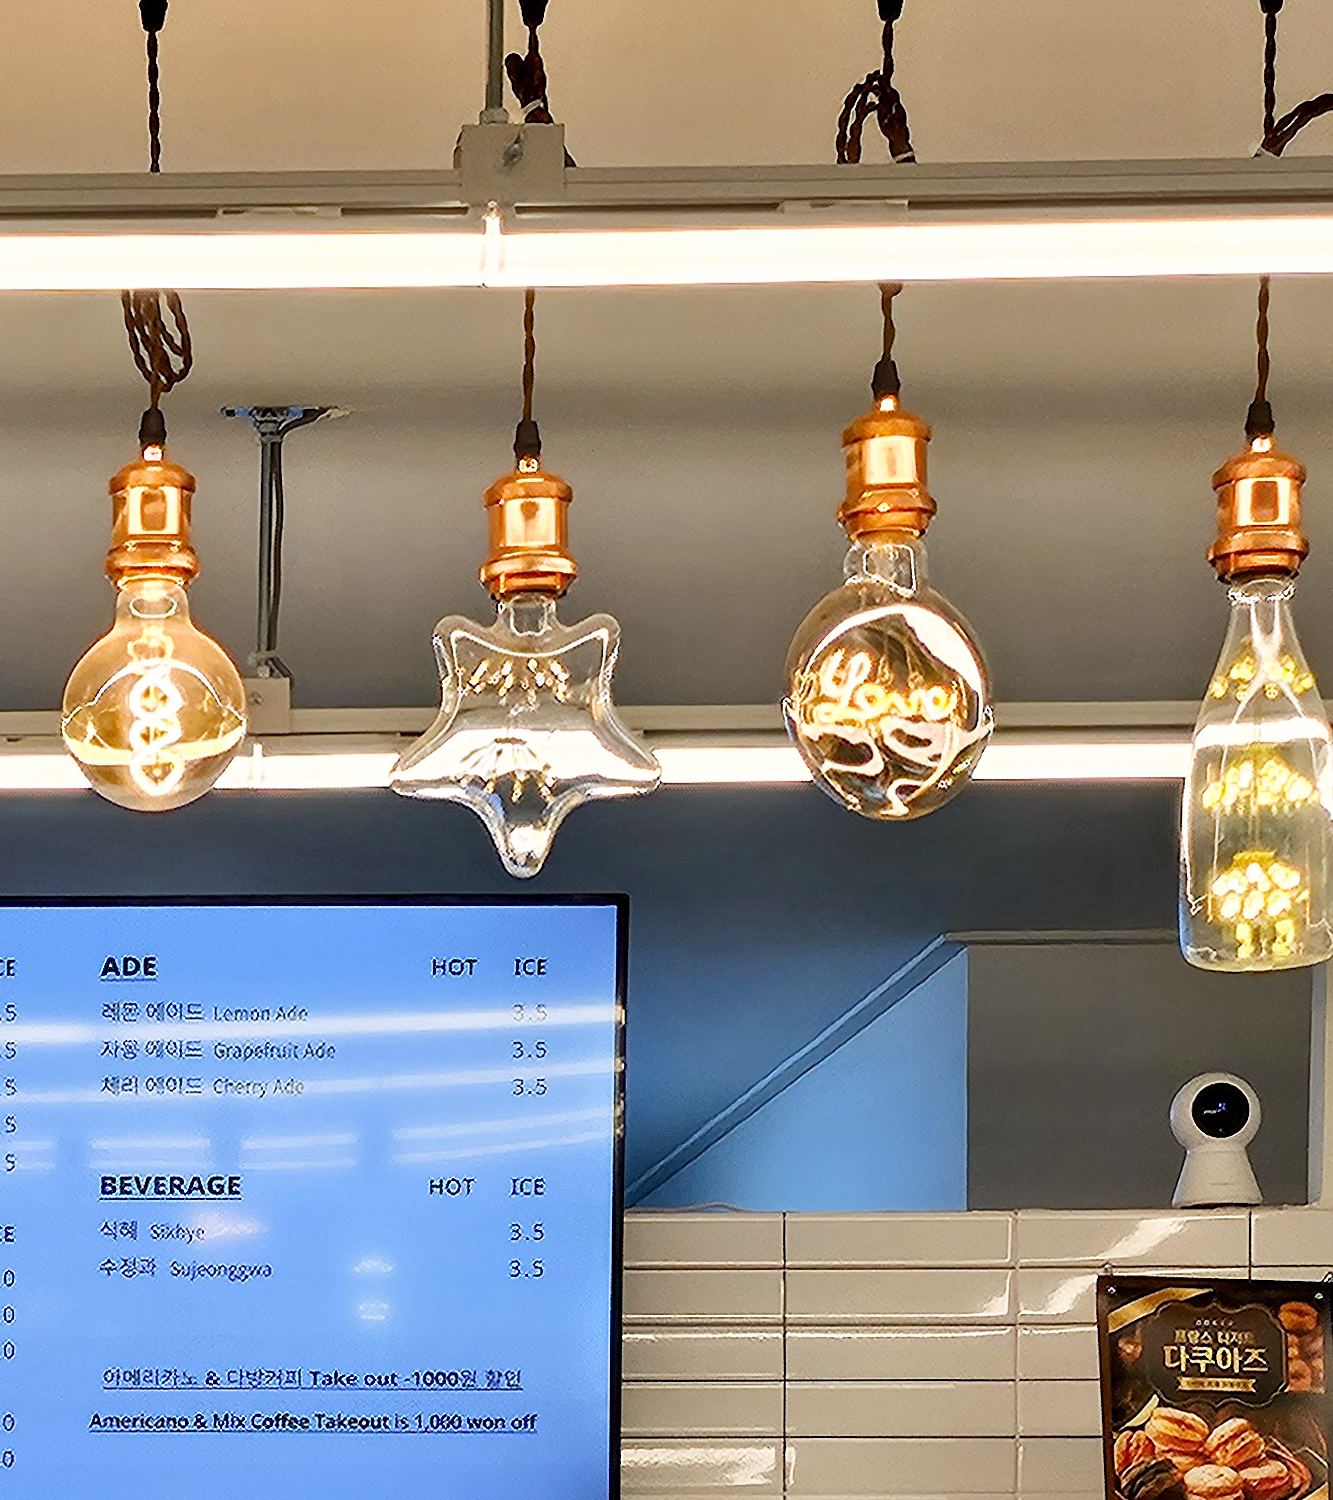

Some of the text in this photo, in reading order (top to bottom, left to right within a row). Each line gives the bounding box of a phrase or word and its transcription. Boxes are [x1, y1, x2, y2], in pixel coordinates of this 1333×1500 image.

[99, 957, 547, 977] ADE HOT ICE
[146, 1002, 203, 1022] 에이드
[213, 1005, 269, 1021] Lemon
[275, 1005, 308, 1021] Ade
[146, 1041, 203, 1060] 에이드
[213, 1043, 298, 1062] Grapefruit
[303, 1043, 335, 1059] Ade
[512, 1041, 547, 1059] 3.5
[146, 1077, 203, 1096] 에이드
[213, 1078, 267, 1097] Cherry
[273, 1078, 304, 1095] Ade
[512, 1078, 547, 1096] 3.5
[99, 1176, 546, 1196] BEVERAGE HOT ICE
[510, 1223, 545, 1241] 3.5
[100, 1258, 157, 1278] 수정과
[510, 1260, 545, 1278] 3.5
[1163, 1345, 1269, 1374] 다쿠아즈
[205, 1371, 221, 1386] &
[310, 1370, 358, 1386] Take
[364, 1372, 398, 1386] out
[89, 1413, 190, 1430] Americano
[194, 1413, 209, 1430] &
[213, 1413, 246, 1430] Mix
[251, 1413, 309, 1430] Coffee
[315, 1413, 389, 1430] Takeout
[467, 1417, 506, 1430] won
[511, 1413, 538, 1430] off
